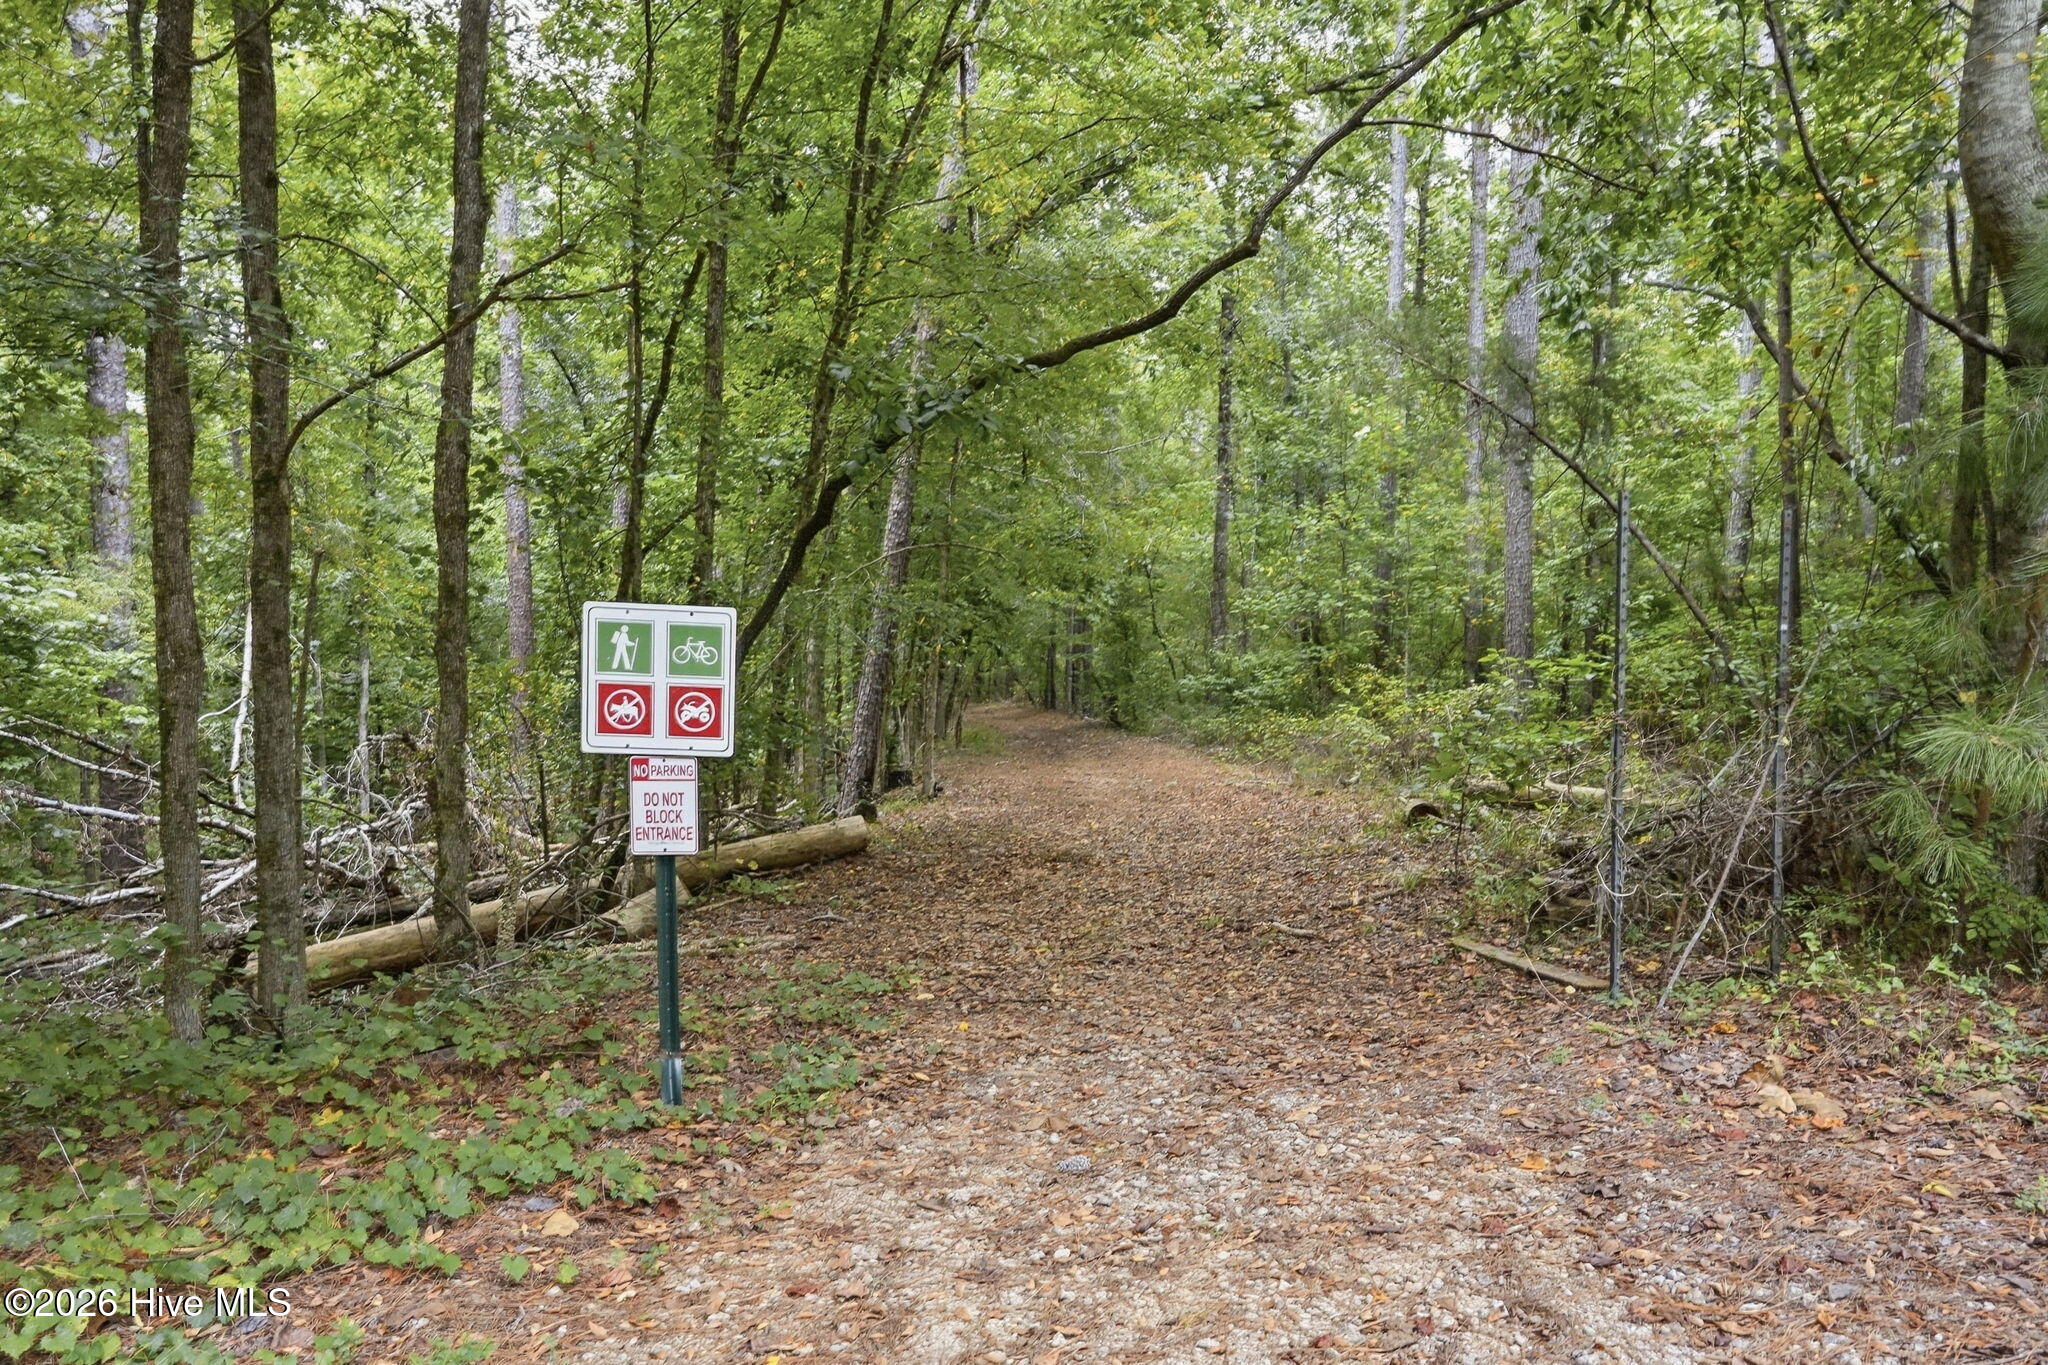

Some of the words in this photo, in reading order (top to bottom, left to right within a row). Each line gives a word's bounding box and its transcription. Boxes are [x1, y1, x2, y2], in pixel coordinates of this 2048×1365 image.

[633, 764, 649, 778] NO
[650, 764, 694, 777] PARKING
[643, 792, 660, 807] DO
[662, 792, 685, 807] NOT
[645, 809, 683, 824] BLOCK
[635, 826, 694, 841] ENTRANCE
